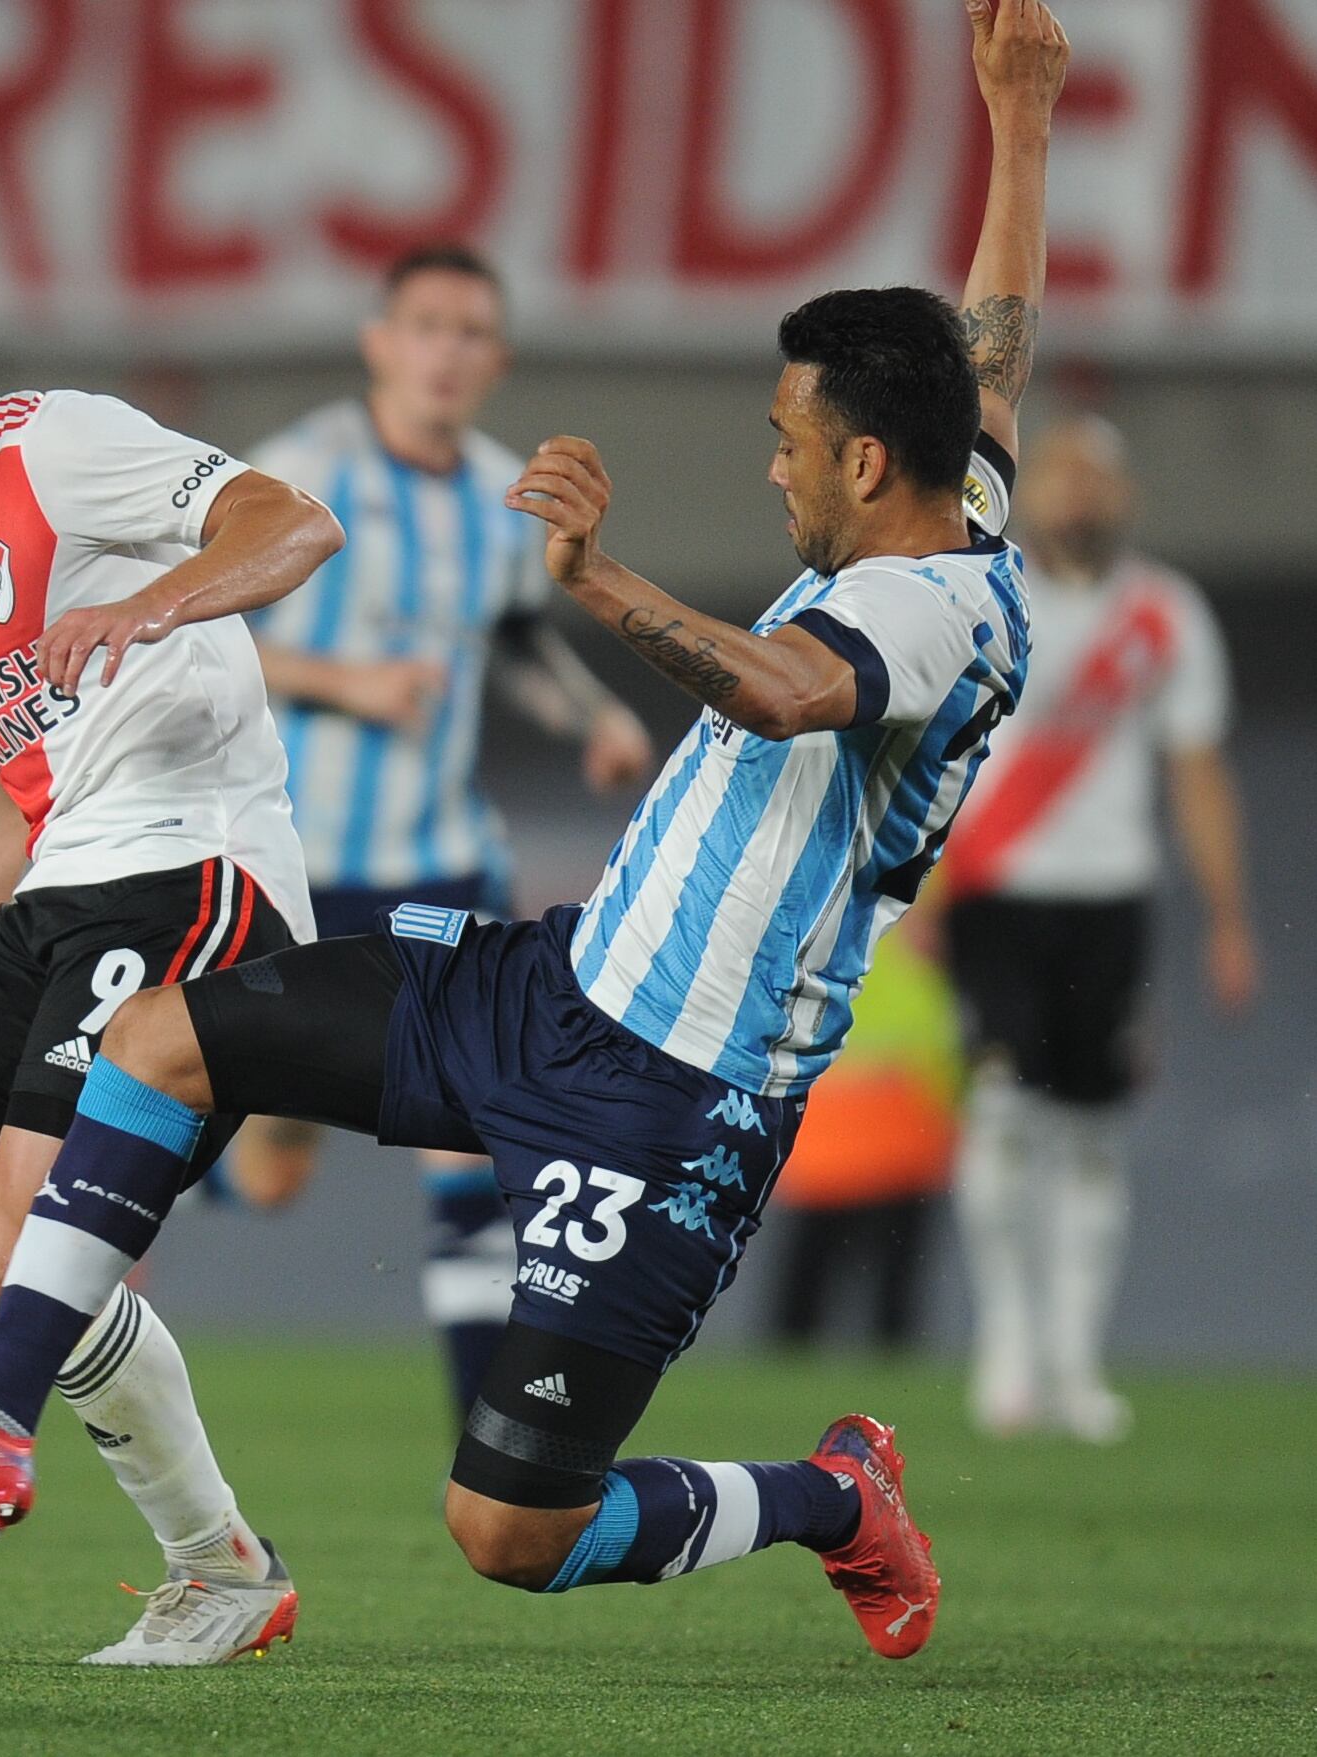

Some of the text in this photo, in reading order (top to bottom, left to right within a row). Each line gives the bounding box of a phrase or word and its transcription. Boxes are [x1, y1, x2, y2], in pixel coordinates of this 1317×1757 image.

[171, 453, 227, 509] code
[77, 947, 146, 1035] 9
[522, 1159, 647, 1262] 23
[524, 1383, 572, 1407] adidas
